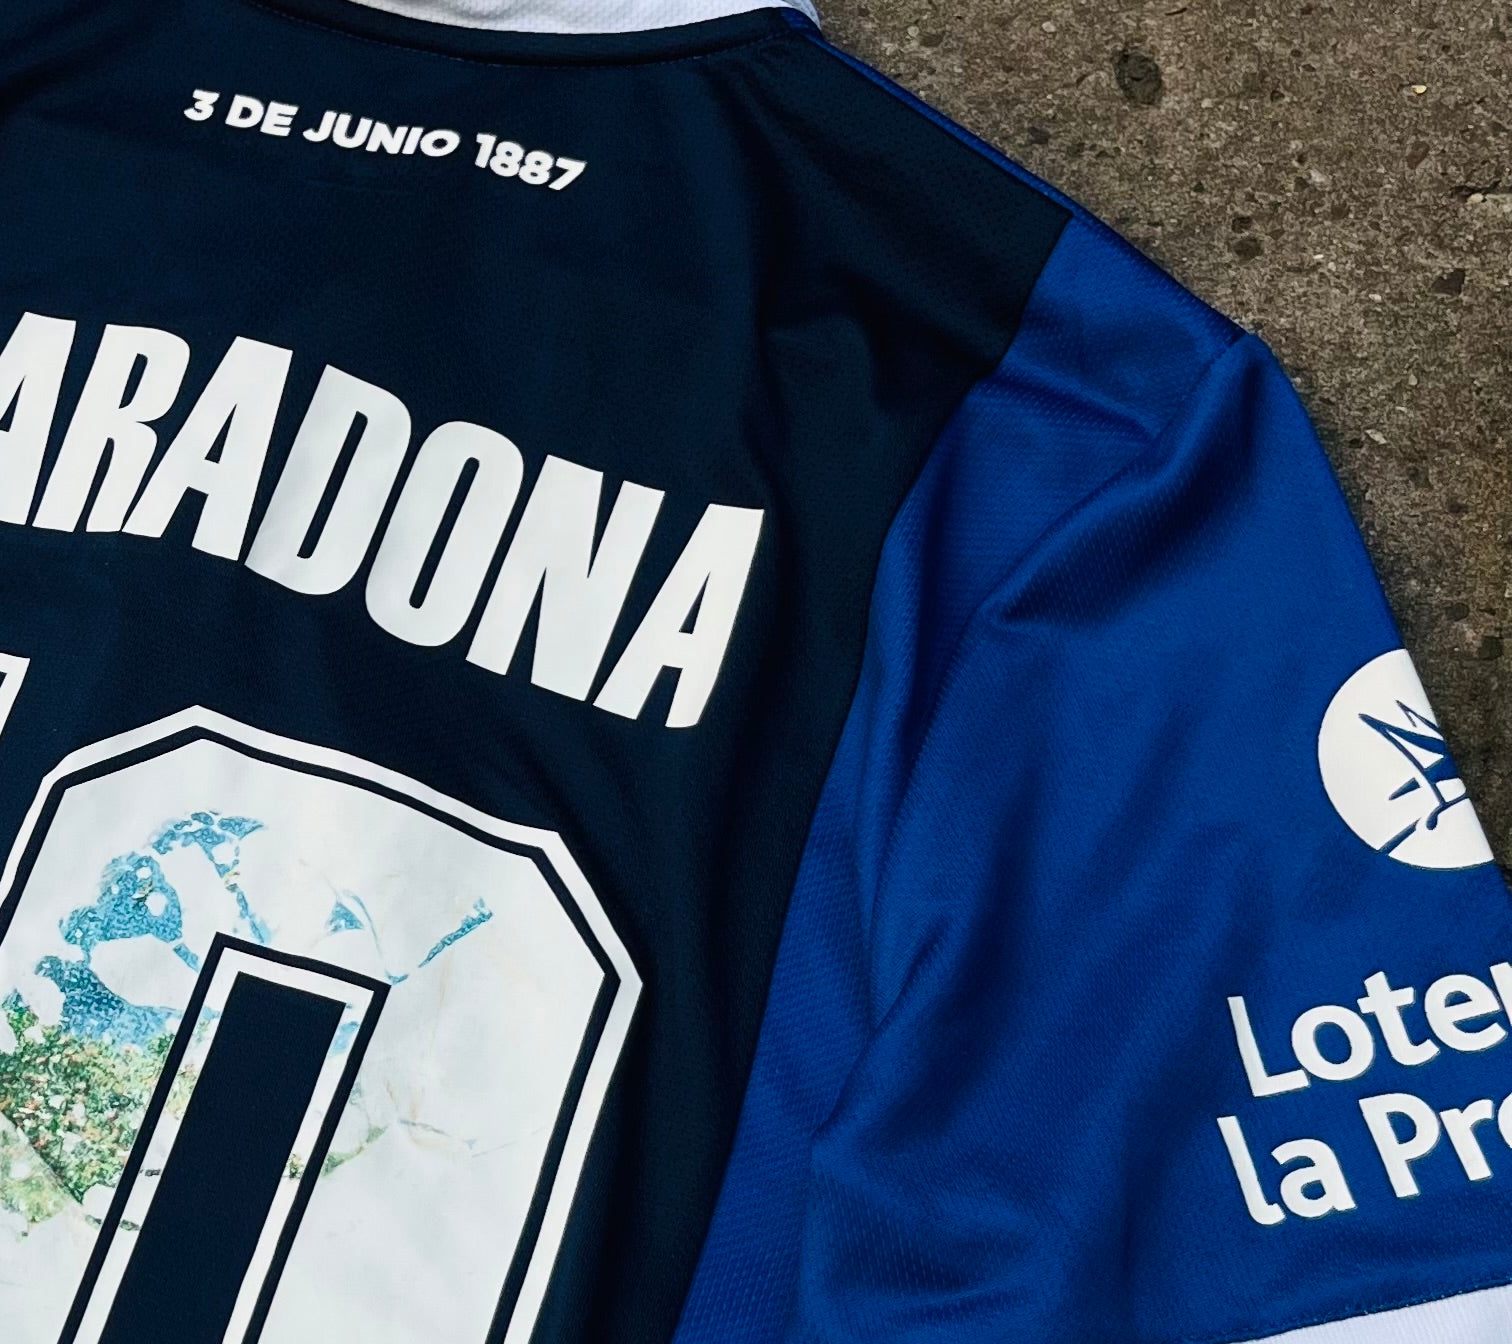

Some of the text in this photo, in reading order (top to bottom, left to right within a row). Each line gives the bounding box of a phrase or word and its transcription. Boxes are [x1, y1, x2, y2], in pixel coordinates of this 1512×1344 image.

[183, 89, 586, 191] 3 DE JUNIO 1887
[1216, 1092, 1512, 1225] la Pr
